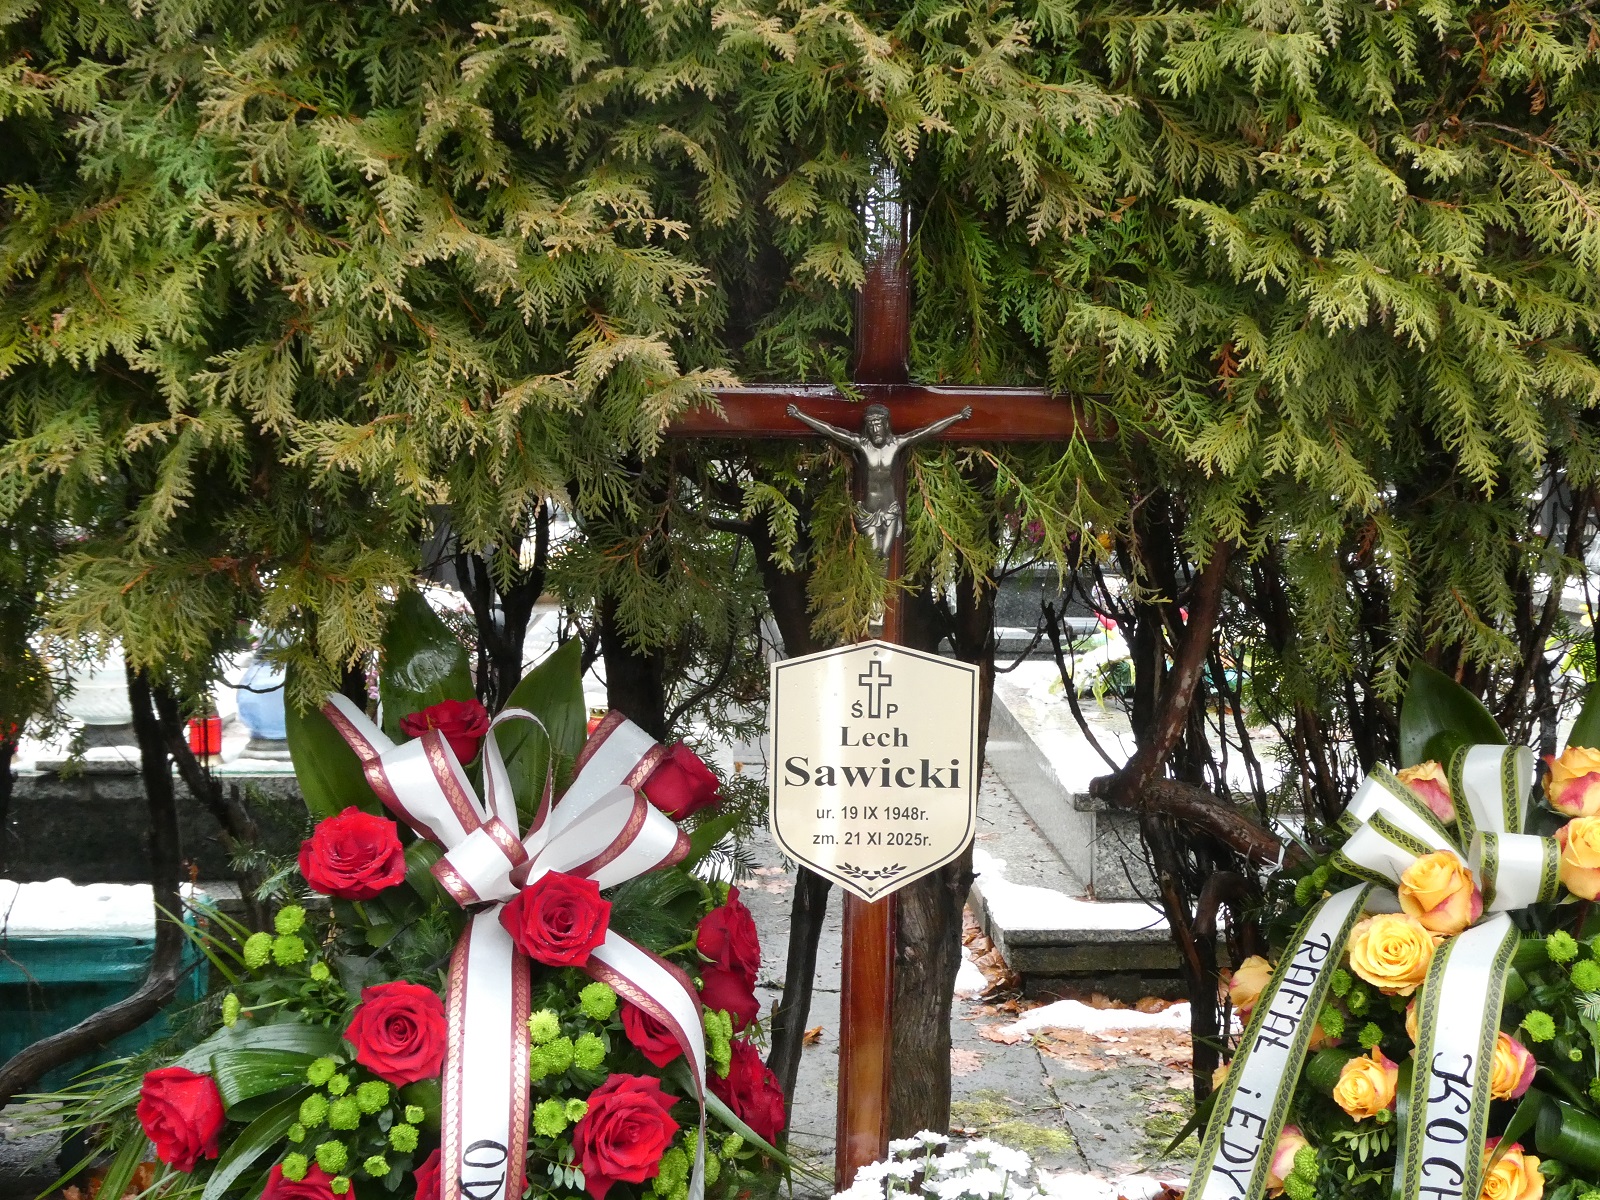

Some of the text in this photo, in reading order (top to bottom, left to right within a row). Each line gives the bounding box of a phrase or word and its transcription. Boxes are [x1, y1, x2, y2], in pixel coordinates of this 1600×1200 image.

[851, 699, 899, 719] Ś P
[839, 726, 909, 747] Lech
[784, 756, 961, 789] Sawicki
[816, 806, 929, 821] ur. 19 IX 1948r.
[812, 832, 932, 846] zm. 21 XI 2025r.
[1252, 932, 1332, 1054] RAFAŁ
[1211, 1106, 1267, 1200] EDY
